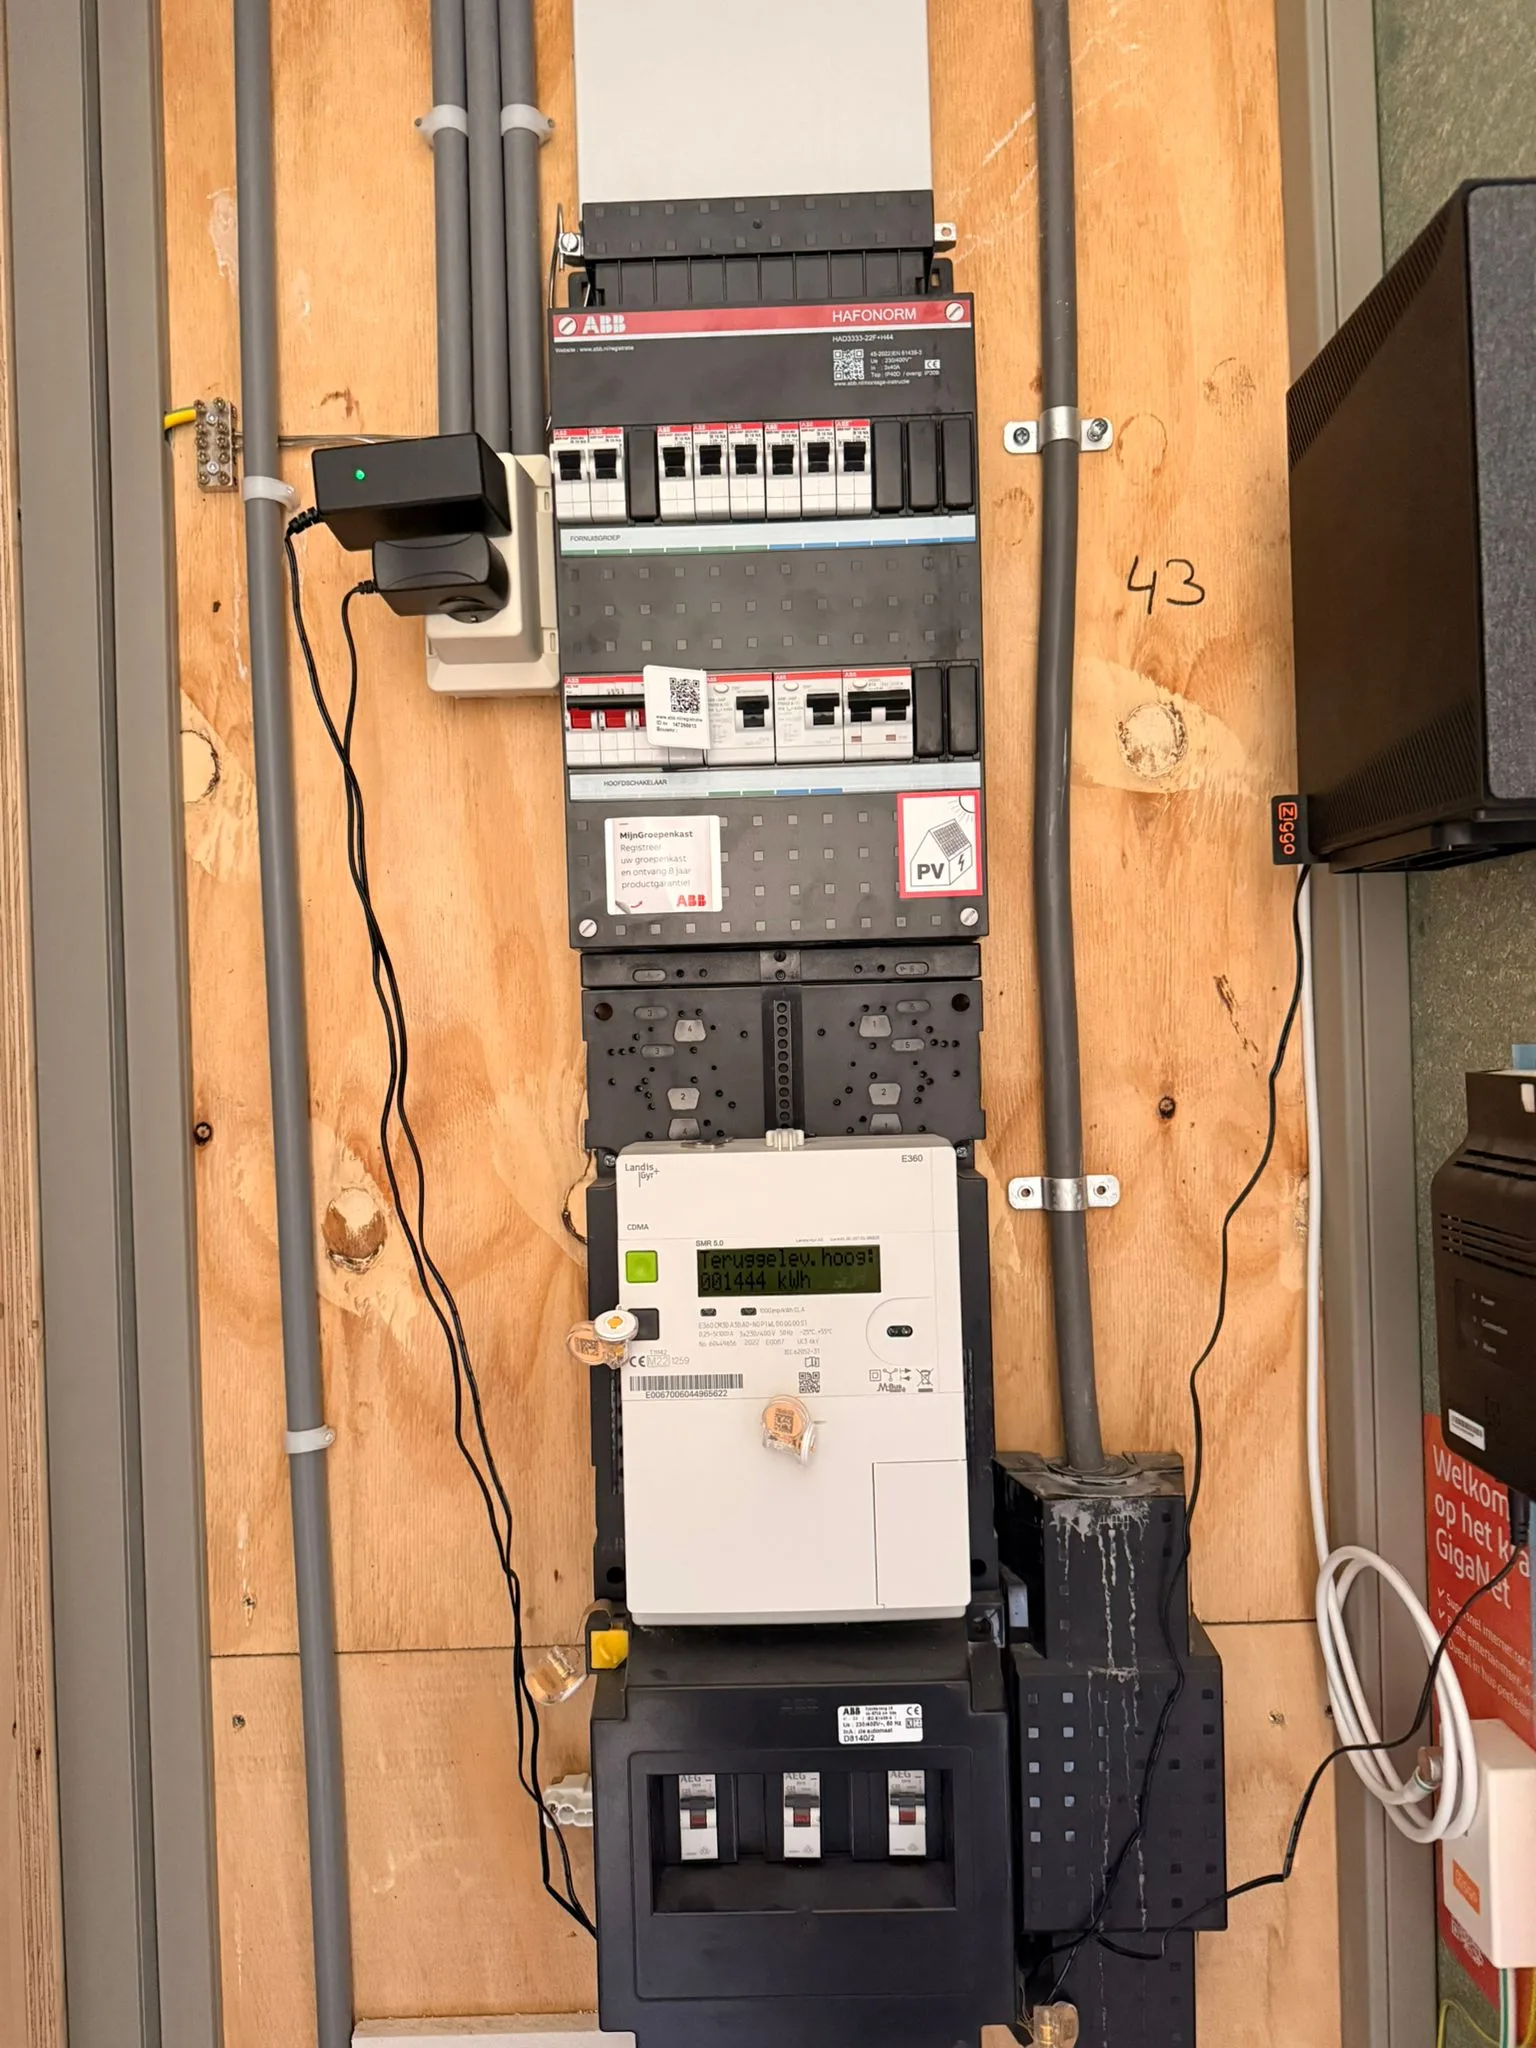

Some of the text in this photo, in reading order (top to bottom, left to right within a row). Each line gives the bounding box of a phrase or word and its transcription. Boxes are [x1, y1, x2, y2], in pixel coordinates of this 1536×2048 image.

[832, 307, 917, 323] HAFONORM
[582, 315, 627, 335] ABB
[1128, 556, 1206, 615] 43
[620, 831, 693, 840] MijnGroepenkast
[635, 855, 687, 864] groepenkast
[633, 869, 667, 877] ontvang
[917, 863, 944, 880] PV
[676, 895, 706, 907] ABB
[687, 1024, 693, 1033] 4
[681, 1092, 686, 1101] 2
[881, 1088, 886, 1096] 2
[901, 1154, 923, 1163] E360
[625, 1163, 654, 1172] Landis
[700, 1271, 811, 1291] 001444 kWh
[672, 1357, 690, 1365] 1259
[645, 1390, 728, 1399] E0067006044965622
[1432, 1444, 1510, 1523] Welkom
[1435, 1493, 1456, 1529] op
[1461, 1501, 1493, 1552] het
[843, 1708, 861, 1716] ABB
[680, 1774, 701, 1783] AEG
